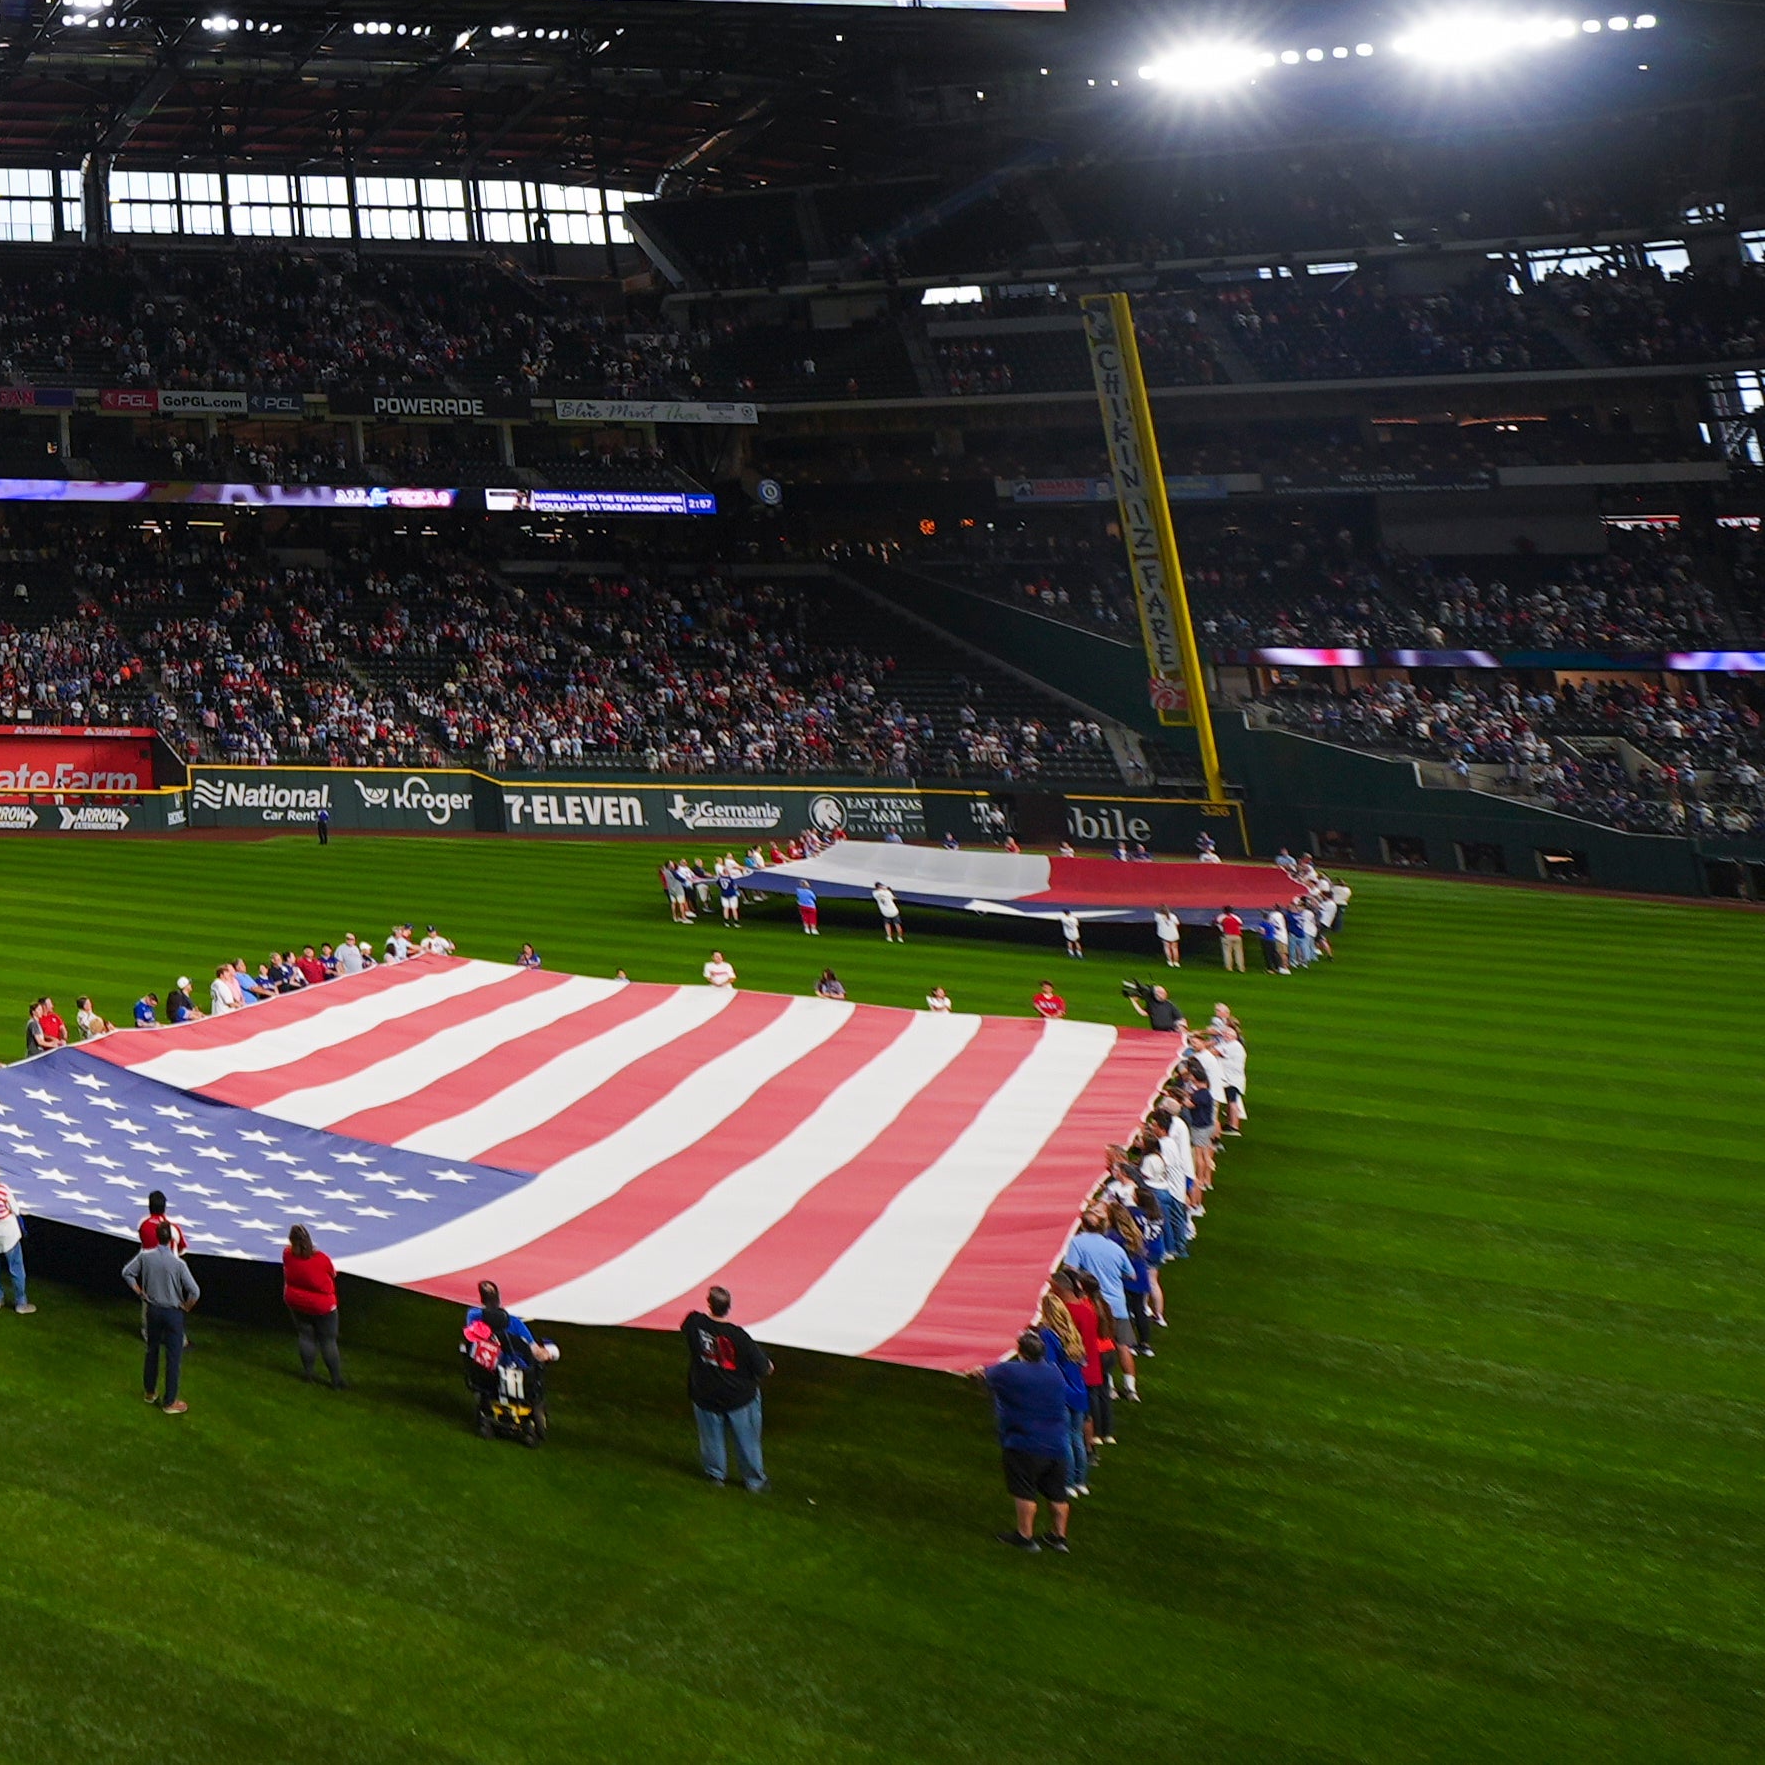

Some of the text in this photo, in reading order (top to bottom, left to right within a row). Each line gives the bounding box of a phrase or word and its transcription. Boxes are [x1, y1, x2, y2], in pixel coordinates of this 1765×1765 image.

[117, 393, 301, 411] PGL GoPGL.com PGL
[372, 396, 486, 417] POWERADE
[558, 401, 603, 419] Blue
[608, 403, 657, 419] Mint
[534, 491, 577, 503] BASEBALL
[578, 492, 598, 503] AND
[614, 493, 642, 505] TEXAS
[642, 493, 683, 505] RANGERS
[688, 498, 714, 511] 2:57
[393, 776, 474, 826] Kroger
[700, 800, 782, 819] Germania
[846, 795, 925, 812] EAST TEXAS
[76, 807, 121, 823] ARROW
[262, 808, 318, 822] Car Rent
[869, 809, 904, 825] A&M
[1199, 804, 1231, 818] 326
[1068, 806, 1152, 843] bile
